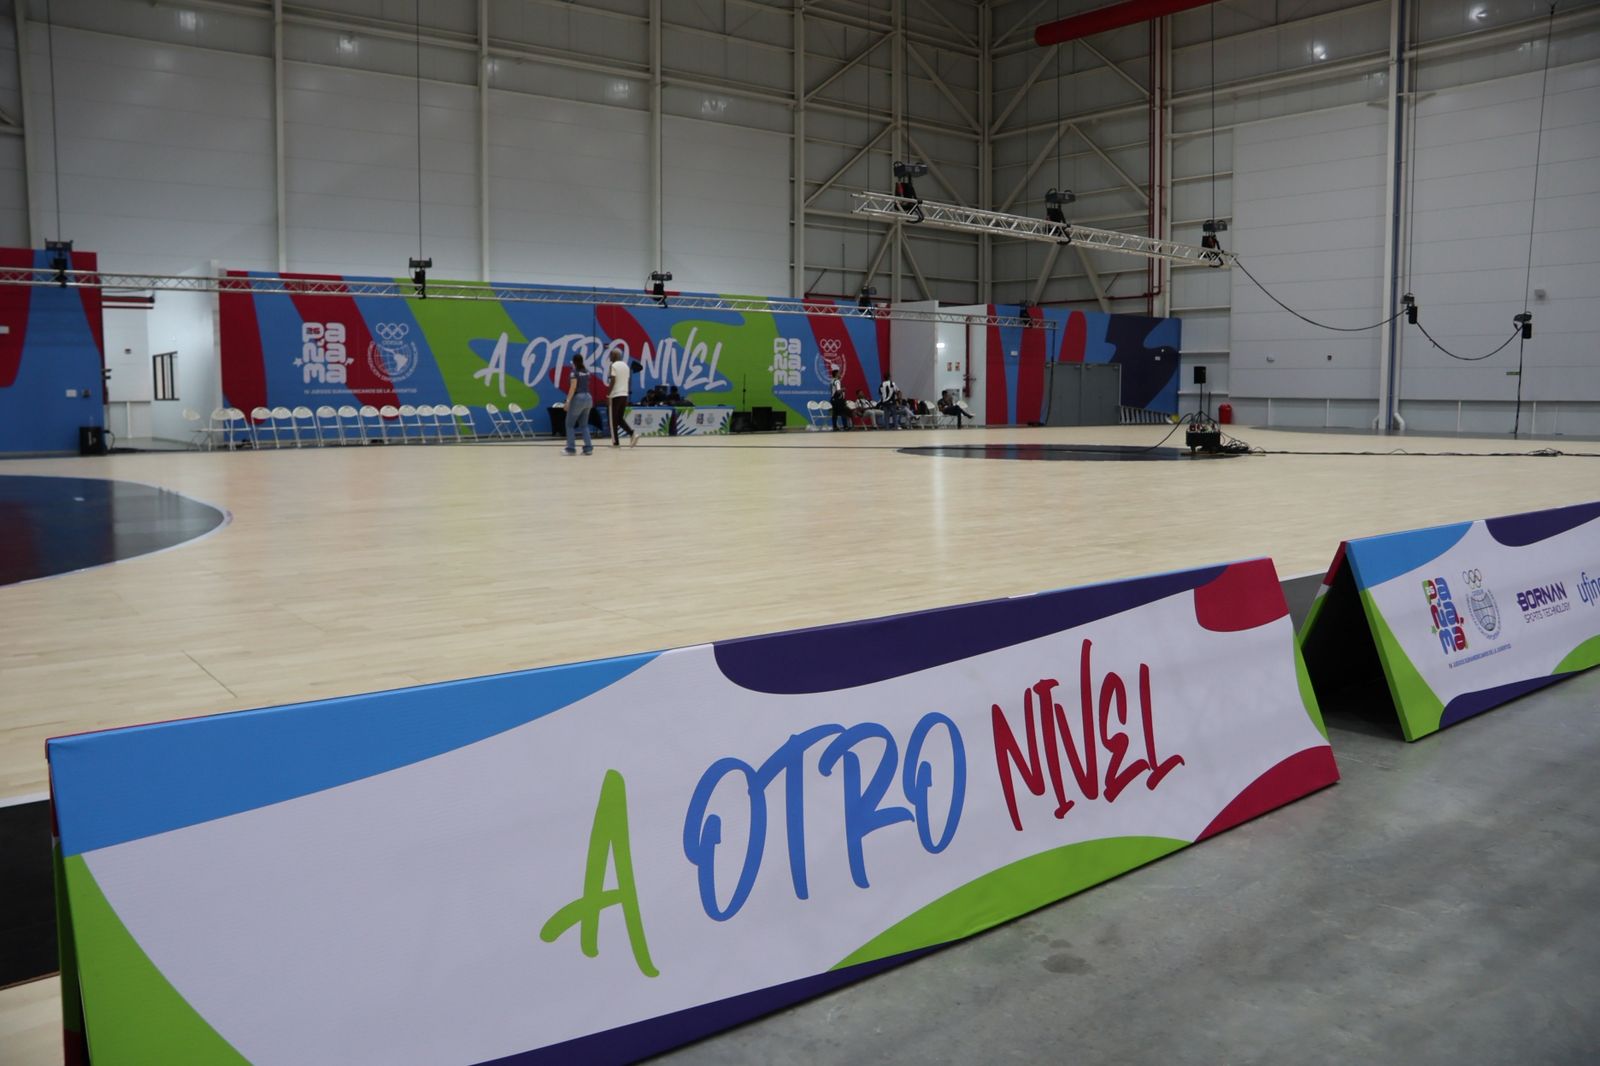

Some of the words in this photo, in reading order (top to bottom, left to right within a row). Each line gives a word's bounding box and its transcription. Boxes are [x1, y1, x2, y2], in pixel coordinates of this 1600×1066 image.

[473, 332, 509, 397] A
[521, 334, 630, 389] OTRO
[640, 327, 728, 389] NIVEL
[1517, 582, 1568, 612] BORNAN
[1524, 610, 1543, 623] SPORTS
[539, 769, 660, 977] A
[683, 712, 966, 921] OTRO
[992, 639, 1185, 831] NIVEL
